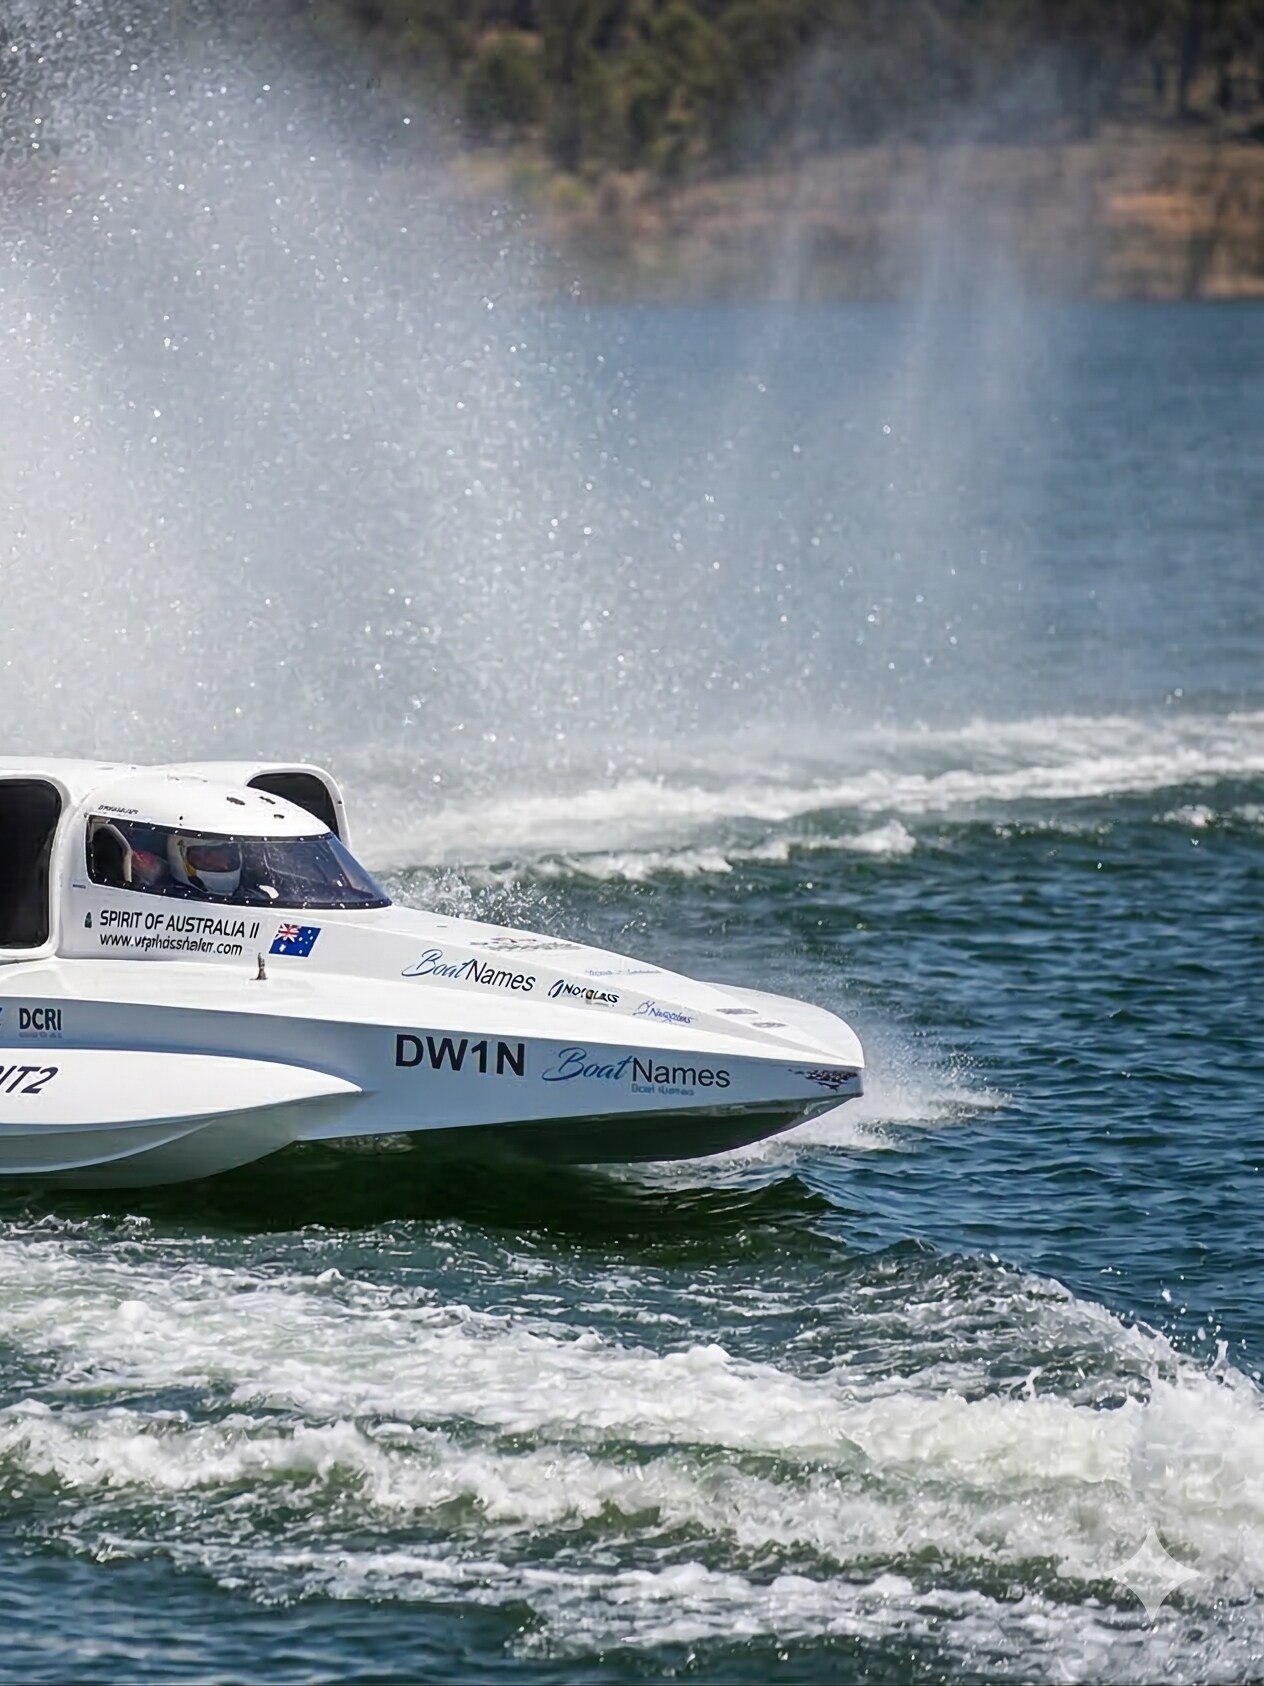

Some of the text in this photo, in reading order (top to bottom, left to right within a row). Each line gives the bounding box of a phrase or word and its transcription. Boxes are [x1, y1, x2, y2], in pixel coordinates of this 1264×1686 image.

[100, 909, 260, 939] SPIRIT OF AUSTRALIA II
[19, 1008, 62, 1031] DCRI
[395, 1033, 525, 1077] DW1N
